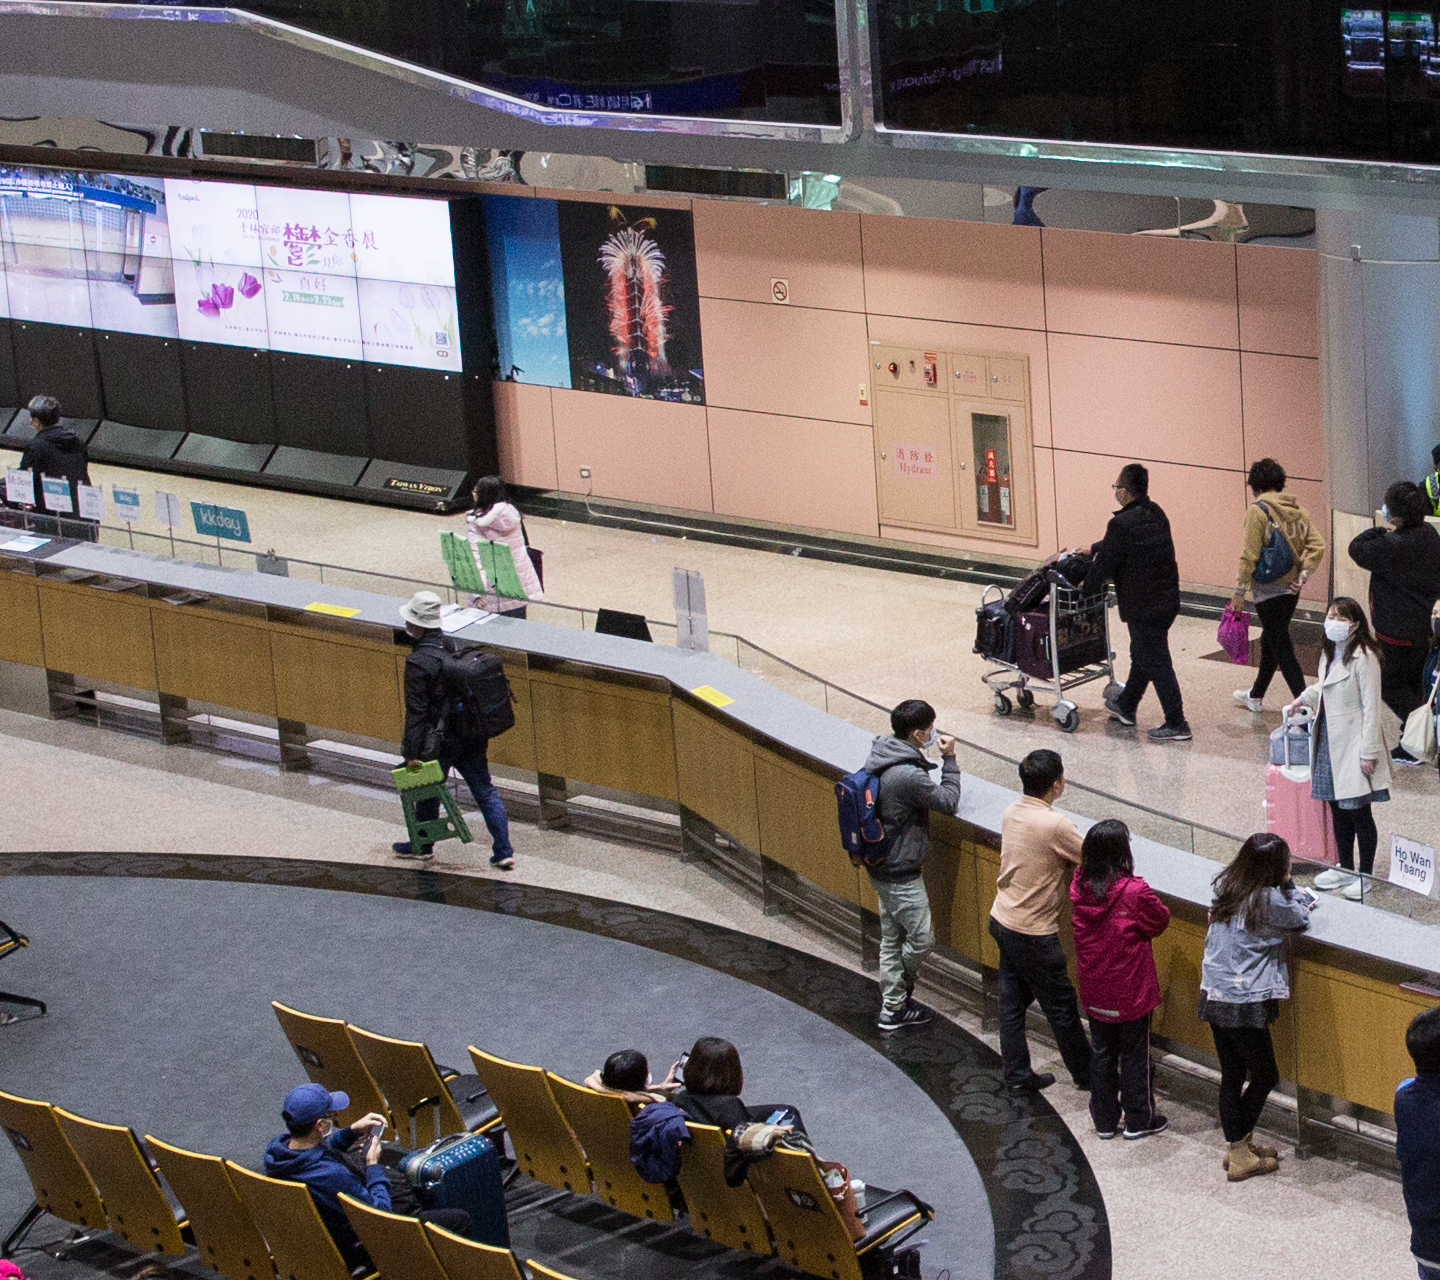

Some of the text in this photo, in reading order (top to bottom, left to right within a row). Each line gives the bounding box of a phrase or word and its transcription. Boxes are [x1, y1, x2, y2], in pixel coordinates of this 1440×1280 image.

[237, 208, 258, 220] 2020
[896, 448, 933, 463] 消防栓
[201, 509, 241, 536] kkday
[1396, 846, 1431, 868] Ho Wan
[1399, 860, 1426, 882] Tsang
